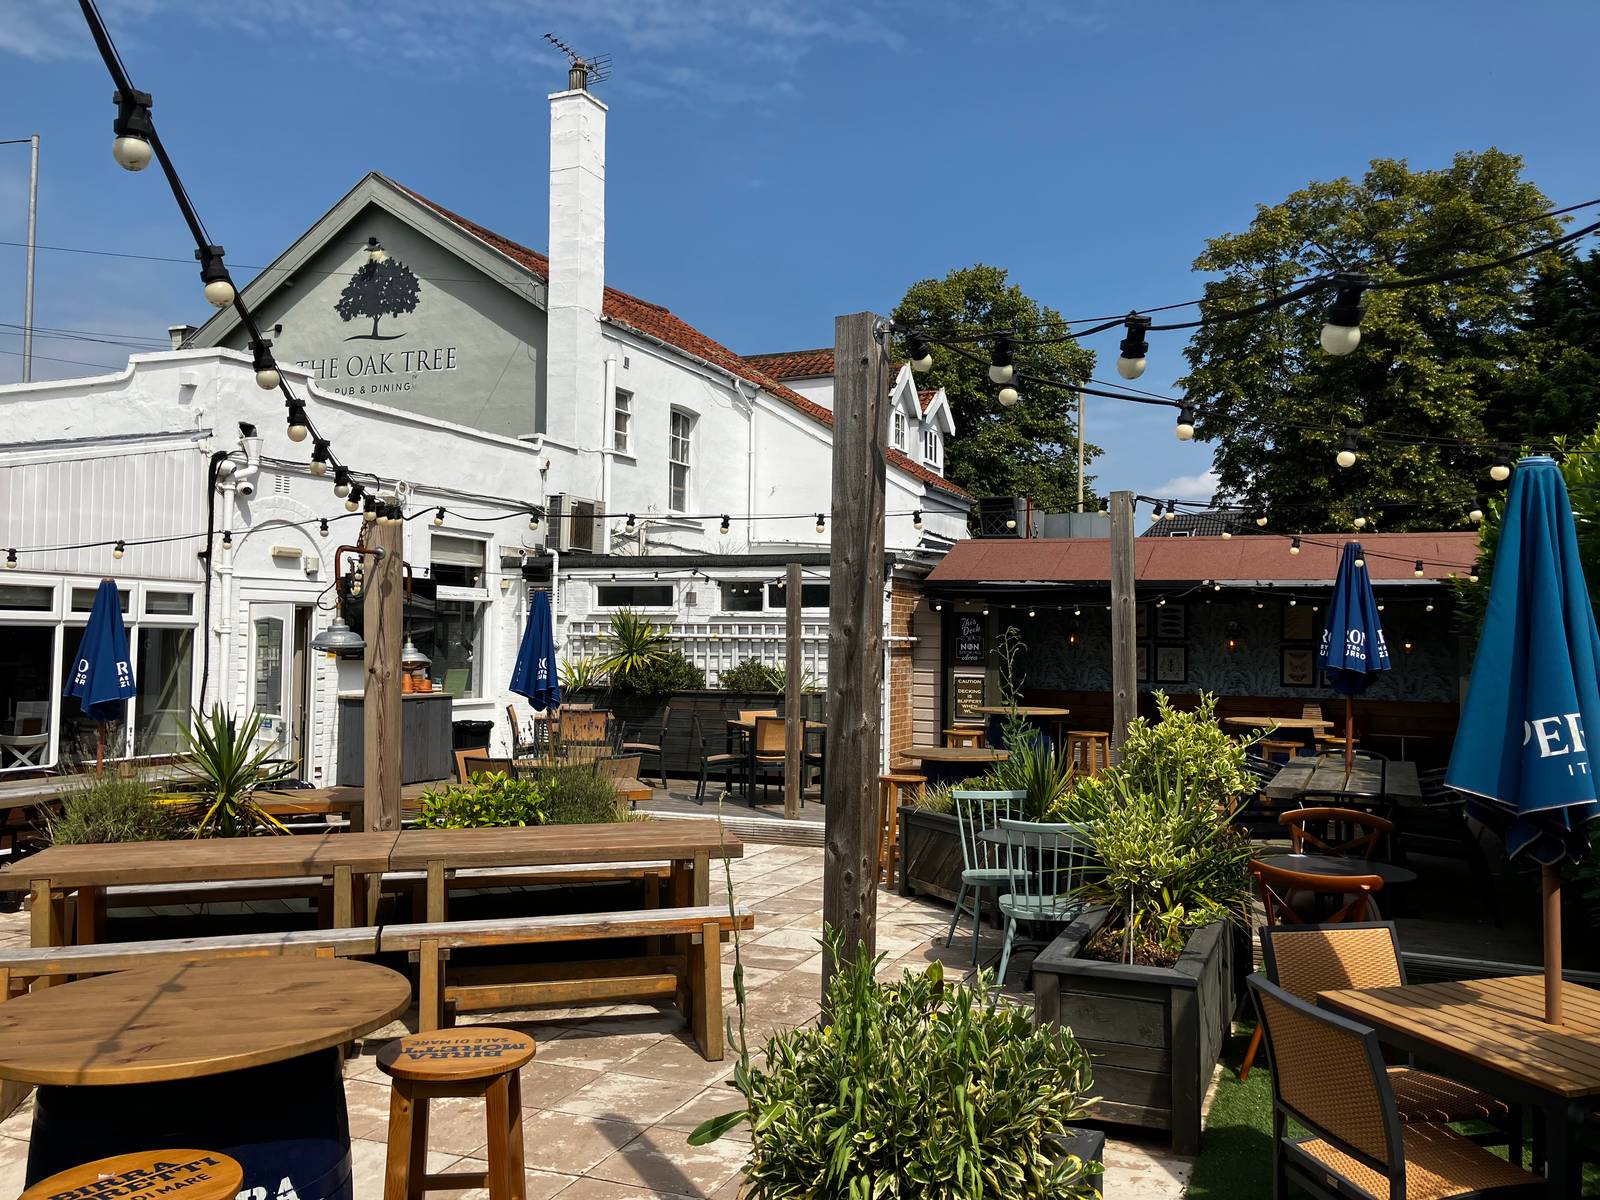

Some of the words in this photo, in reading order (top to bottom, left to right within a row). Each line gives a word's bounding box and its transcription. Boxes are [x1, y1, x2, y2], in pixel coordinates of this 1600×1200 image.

[296, 358, 338, 380] HE
[346, 352, 395, 377] OAK
[400, 347, 457, 373] TREE
[359, 386, 366, 395] &
[371, 382, 412, 394] DINING
[960, 643, 980, 651] NON
[404, 1043, 528, 1054] MORETT
[47, 1162, 180, 1200] BIRRA
[155, 1173, 213, 1195] MARE
